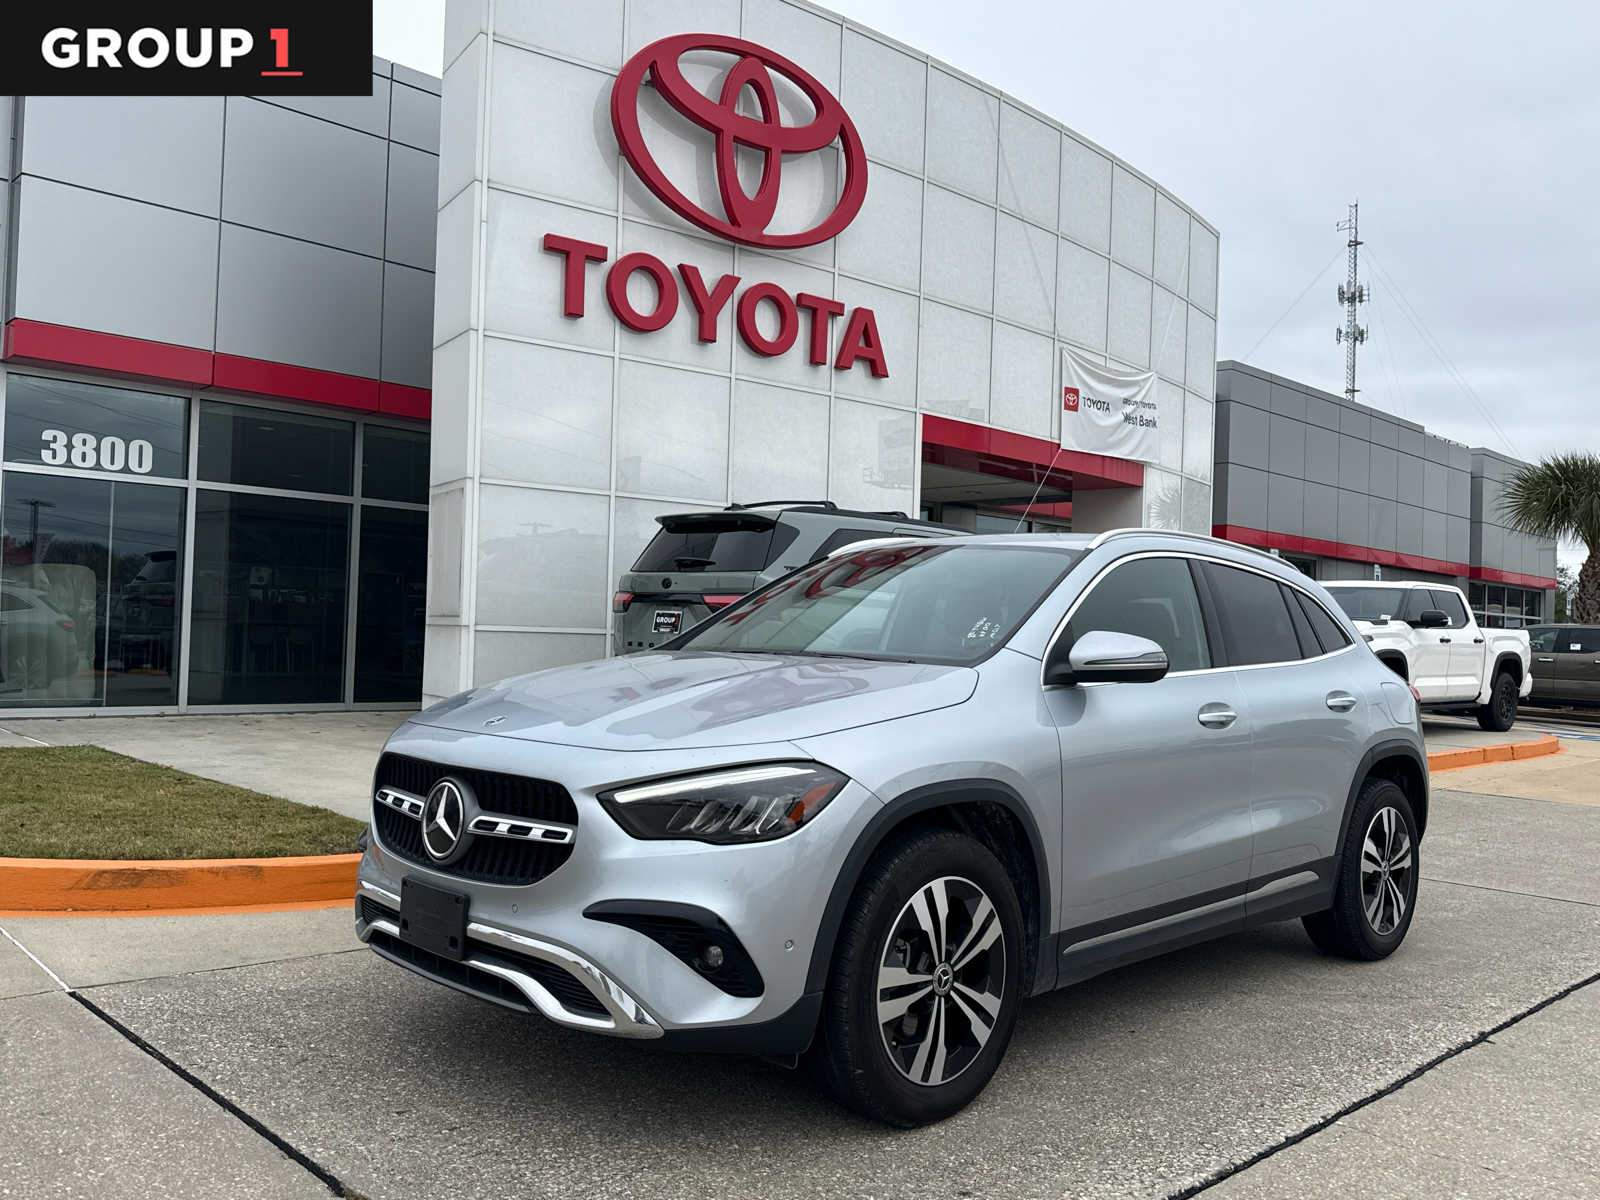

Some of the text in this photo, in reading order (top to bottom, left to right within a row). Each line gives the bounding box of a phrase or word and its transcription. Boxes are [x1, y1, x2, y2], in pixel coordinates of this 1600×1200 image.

[543, 232, 889, 378] TOYOTA
[1082, 396, 1111, 413] TOYOTA
[1121, 411, 1158, 428] West Bank
[40, 429, 153, 474] 3800
